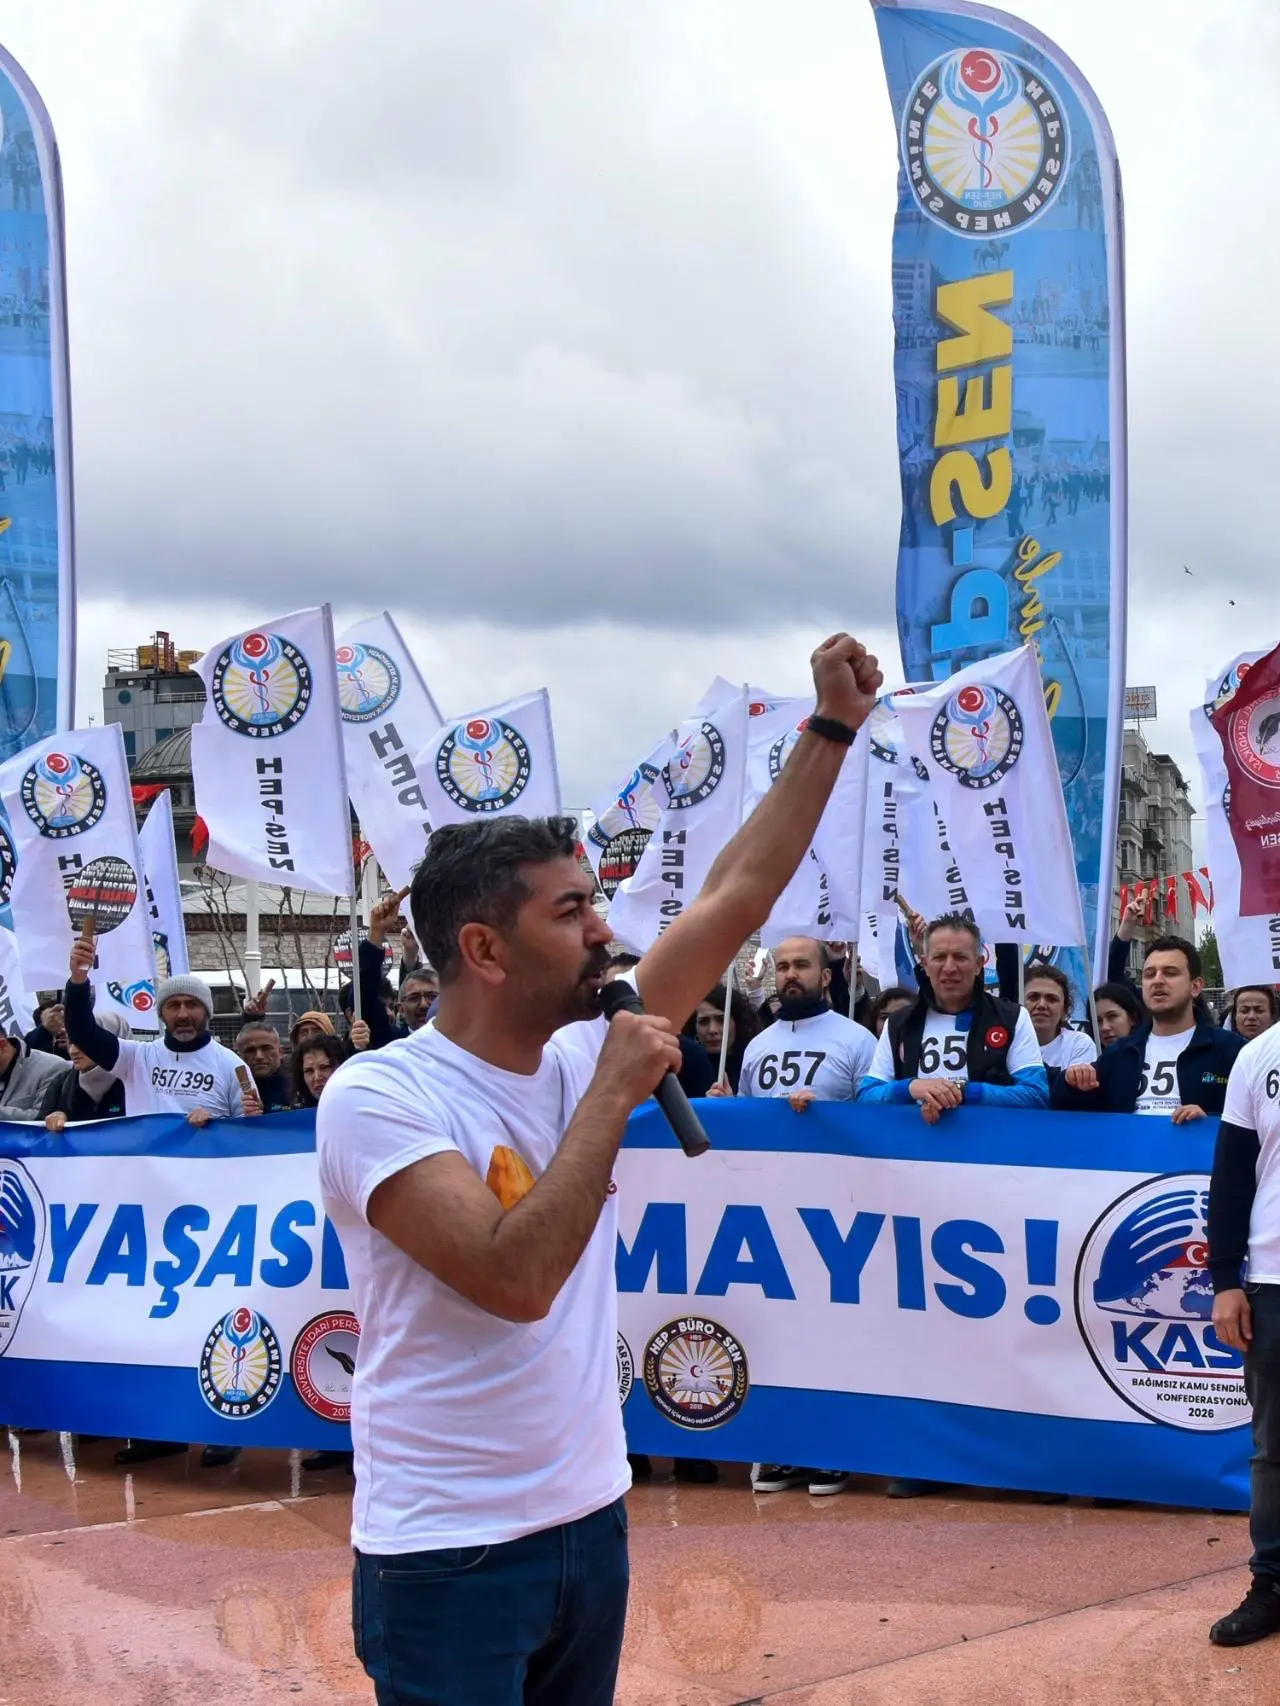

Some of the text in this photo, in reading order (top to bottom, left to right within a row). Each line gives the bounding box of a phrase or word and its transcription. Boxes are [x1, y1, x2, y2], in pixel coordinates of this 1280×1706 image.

[758, 1051, 826, 1091] 657
[919, 1035, 967, 1074] 65
[151, 1066, 215, 1092] 657/399
[47, 1200, 1061, 1326] YAŞASI MAYIS!
[650, 1332, 670, 1356] HEP
[678, 1317, 715, 1334] BÜRO
[722, 1337, 743, 1363] SEN
[1110, 1320, 1243, 1371] KAS
[200, 1323, 223, 1402] HEP-SEN
[220, 1403, 250, 1415] HEP
[1132, 1377, 1248, 1394] BAĞIMSIZ KAMU SENDİK
[1156, 1393, 1248, 1406] KONFEDERASYONU
[1188, 1407, 1214, 1419] 2026
